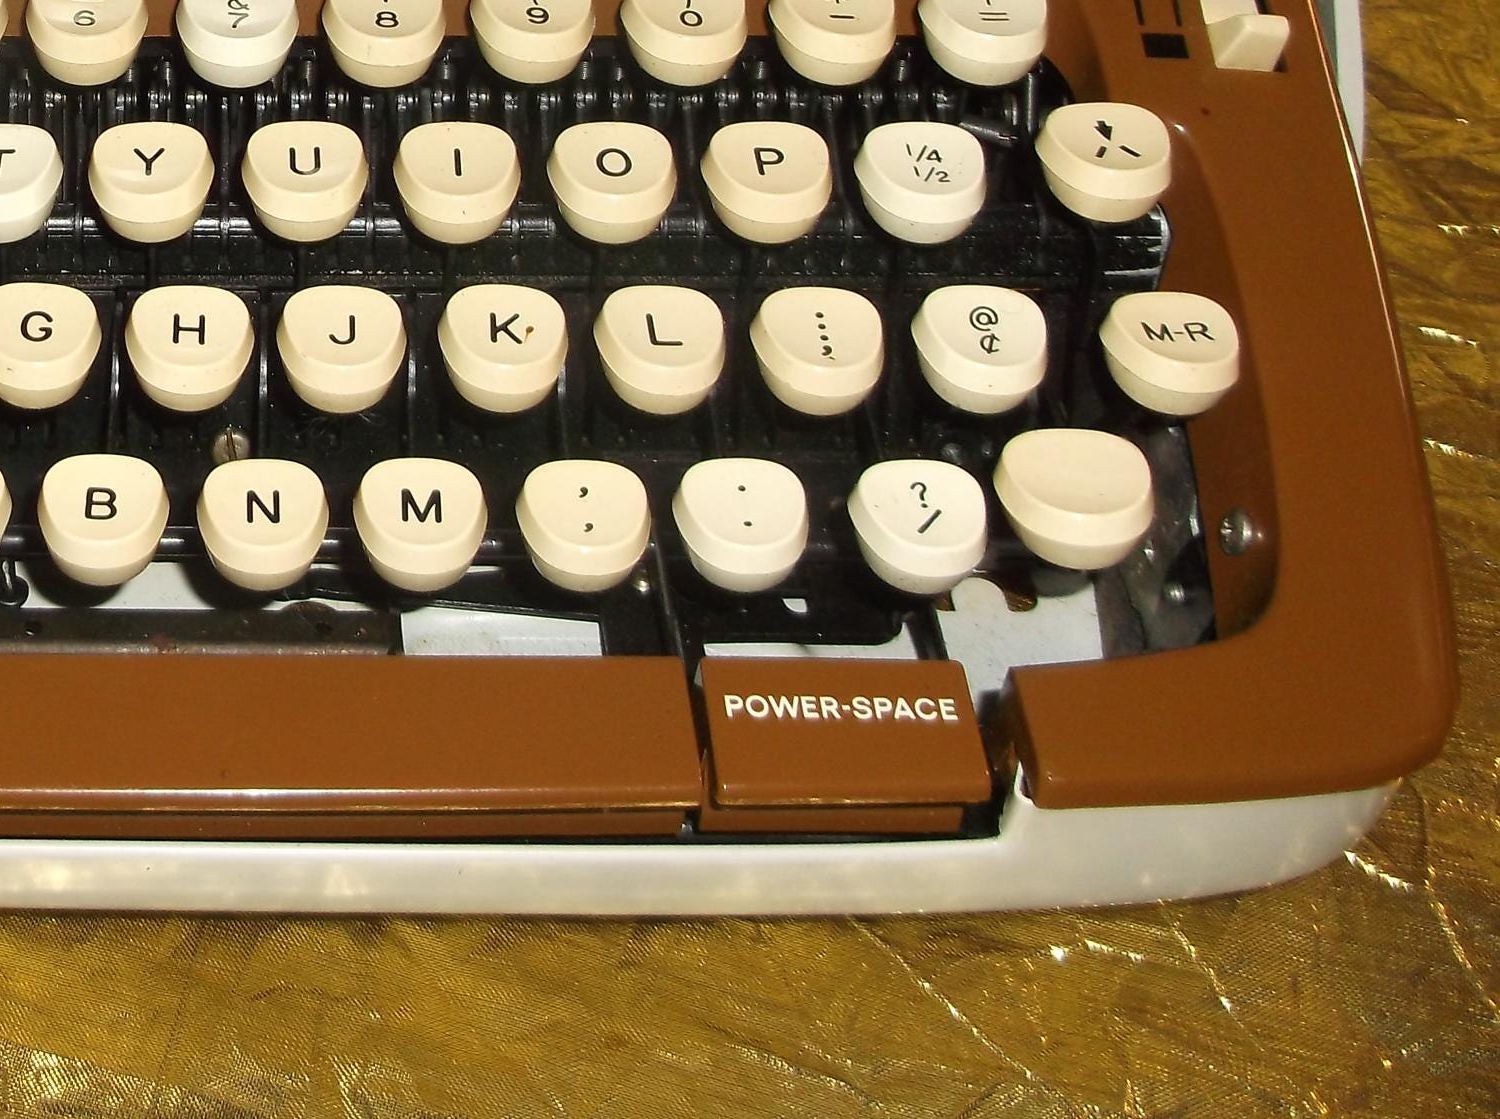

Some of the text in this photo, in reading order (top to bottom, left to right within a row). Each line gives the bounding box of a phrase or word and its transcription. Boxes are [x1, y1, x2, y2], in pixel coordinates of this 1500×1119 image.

[73, 9, 96, 27] 6
[227, 11, 249, 29] 7
[375, 11, 399, 29] 8
[525, 6, 550, 25] 9
[133, 147, 165, 176] Y
[289, 146, 321, 176] U
[453, 148, 463, 177] I
[595, 147, 633, 178] O
[753, 147, 785, 176] P
[20, 310, 54, 343] G
[172, 313, 206, 346] H
[328, 314, 356, 346] J
[489, 312, 523, 345] K
[645, 313, 684, 347] L
[1140, 321, 1215, 342] M-R
[84, 487, 118, 521] B
[246, 490, 281, 524] N
[401, 488, 443, 524] M
[724, 694, 959, 721] POWER-SPACE
